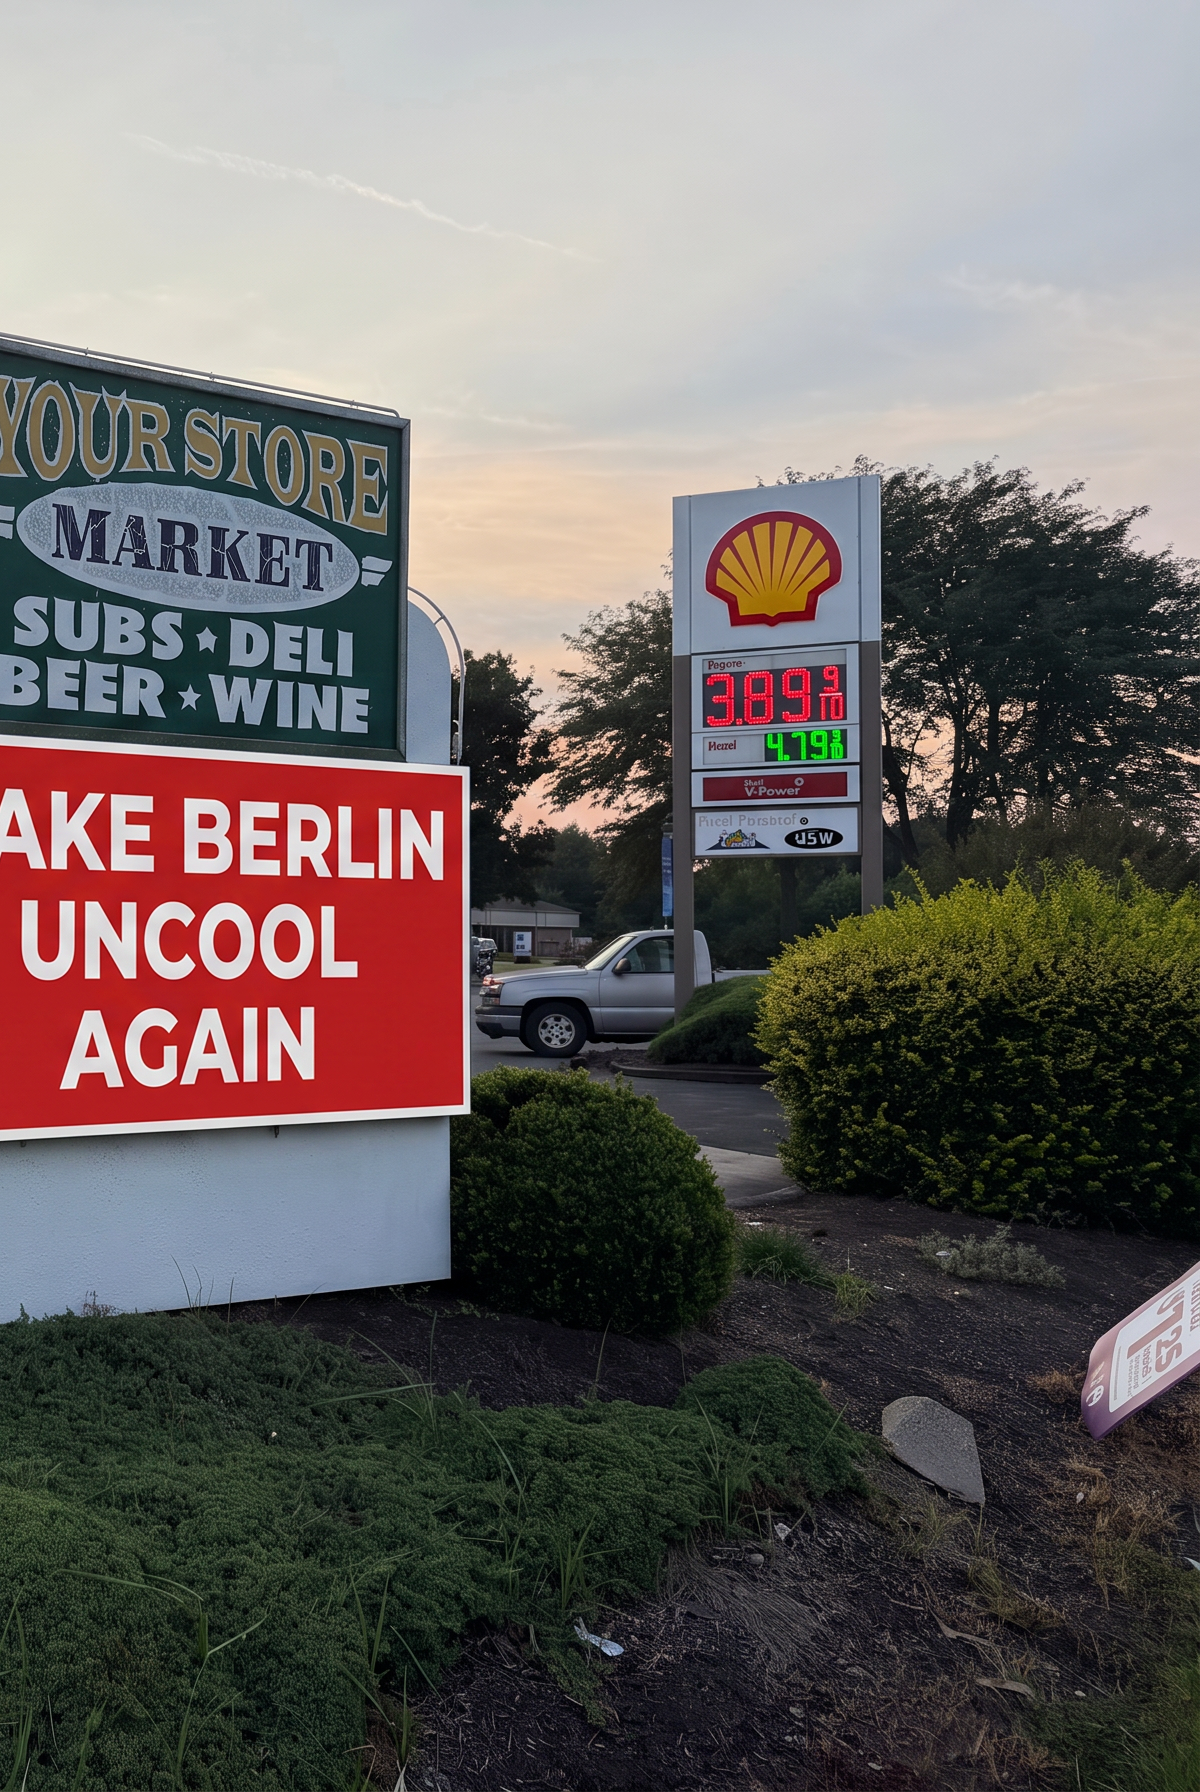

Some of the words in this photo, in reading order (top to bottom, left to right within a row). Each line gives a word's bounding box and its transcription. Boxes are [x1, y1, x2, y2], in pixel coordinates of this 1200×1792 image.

[183, 407, 388, 535] STORE
[51, 503, 333, 592] MARKET
[13, 595, 184, 661] SUBS
[228, 617, 354, 678] DELI
[208, 673, 370, 734] WINE
[744, 785, 801, 797] V-Power
[183, 797, 445, 881] BERLIN
[20, 900, 359, 981] UNCOOL
[59, 1006, 316, 1090] AGAIN
